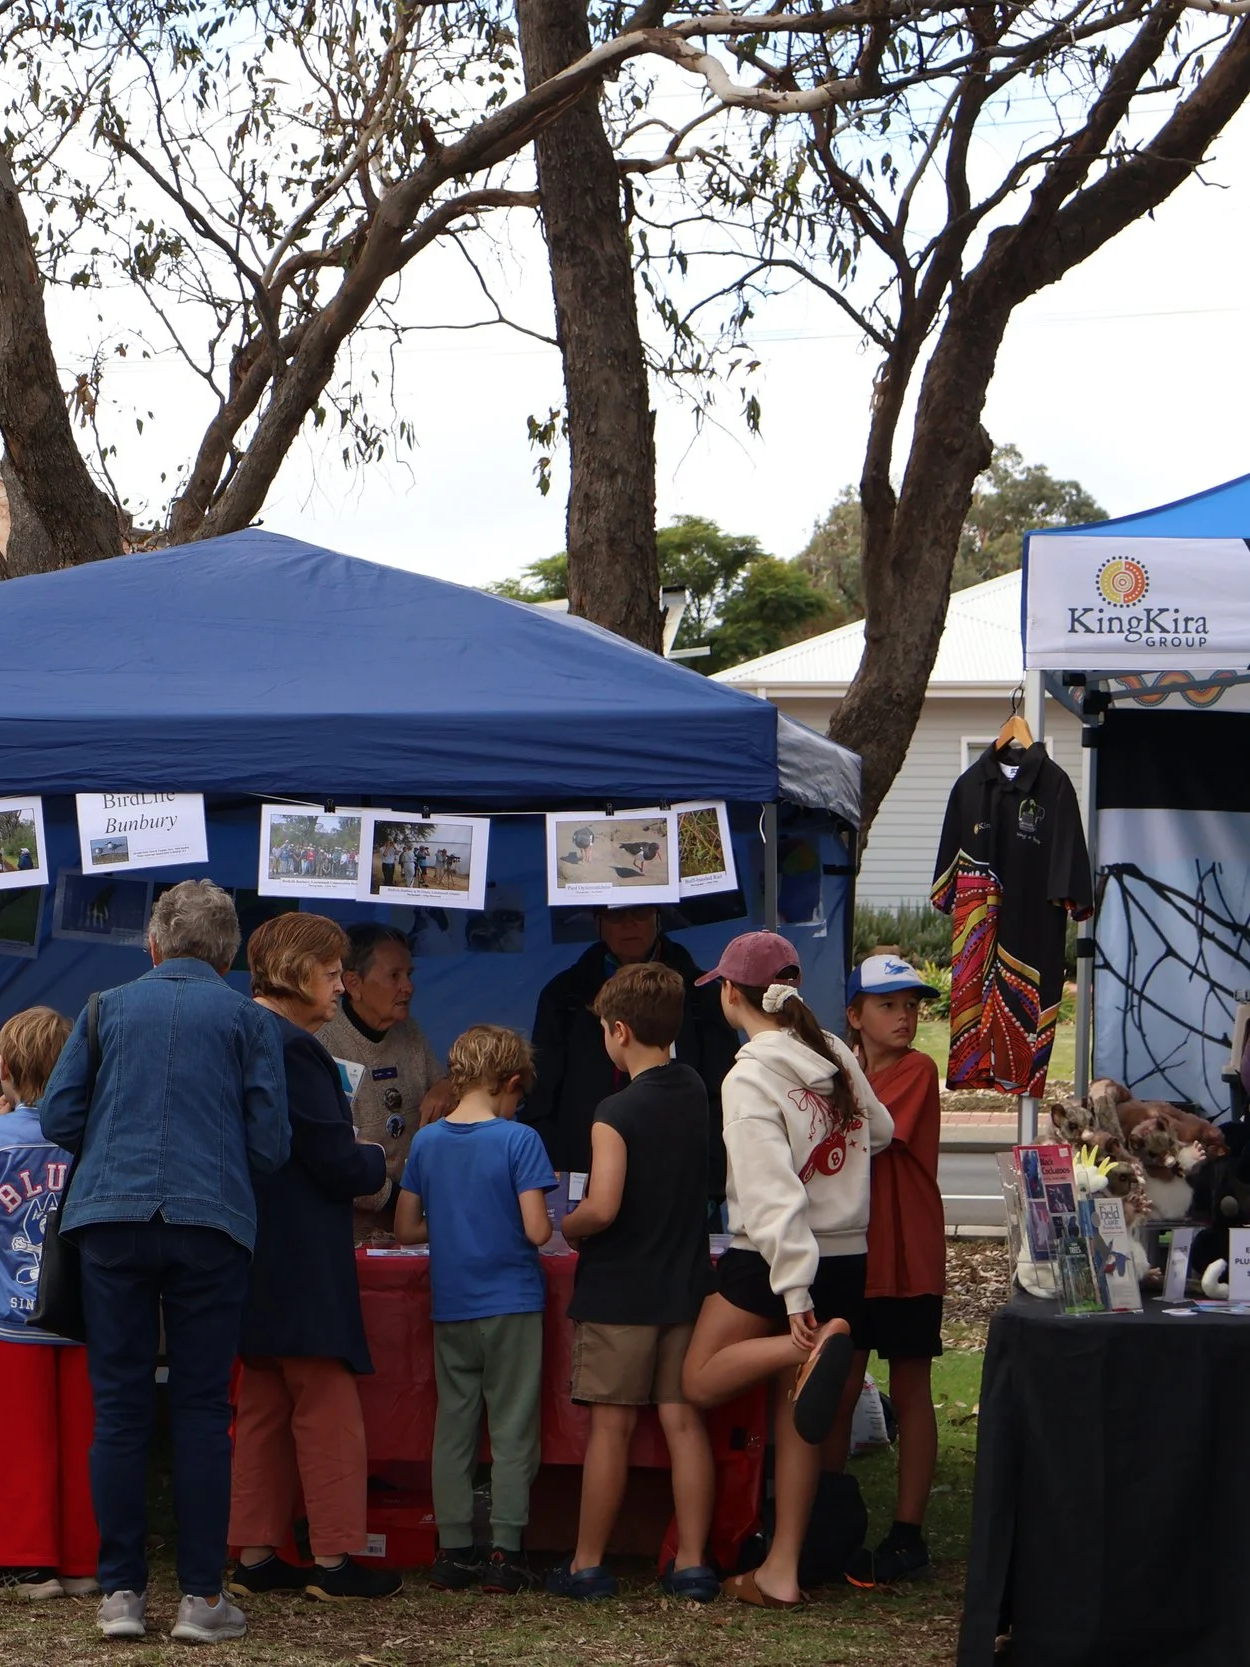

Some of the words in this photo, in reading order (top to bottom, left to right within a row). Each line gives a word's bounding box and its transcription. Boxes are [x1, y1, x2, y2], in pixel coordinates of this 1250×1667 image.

[1067, 607, 1209, 643] KingKira
[1145, 636, 1207, 648] GROUP
[105, 813, 178, 834] Bunbury
[10, 1296, 35, 1310] SIN
